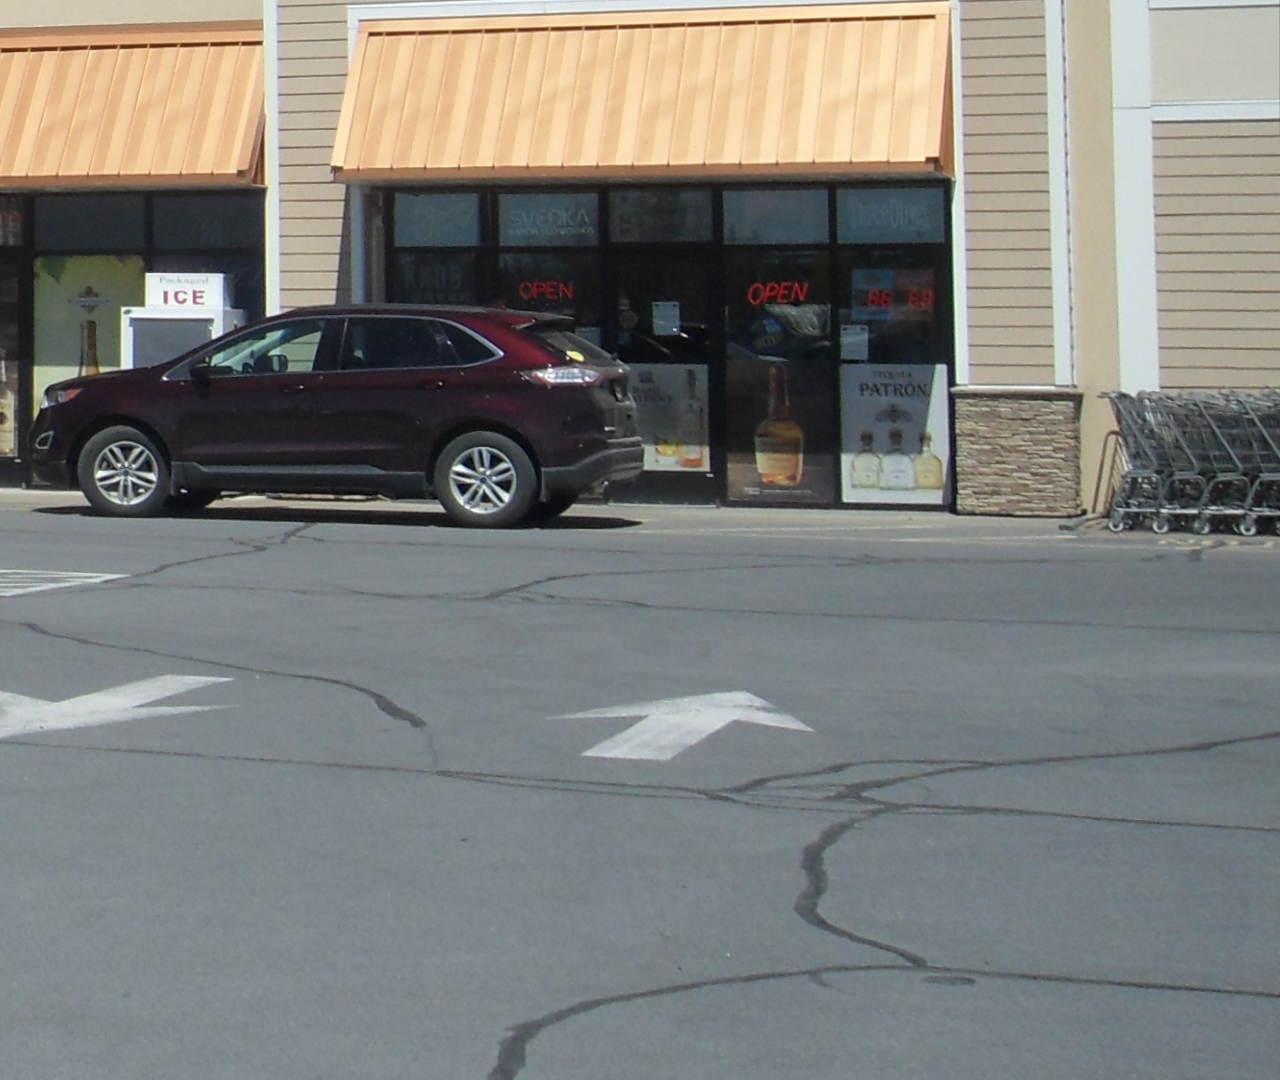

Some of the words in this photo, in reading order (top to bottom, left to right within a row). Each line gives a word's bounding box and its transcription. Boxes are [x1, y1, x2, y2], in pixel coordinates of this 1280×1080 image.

[159, 277, 209, 285] Packaged
[163, 290, 205, 305] ICE
[519, 281, 574, 300] OPEN
[747, 280, 809, 305] OPEN
